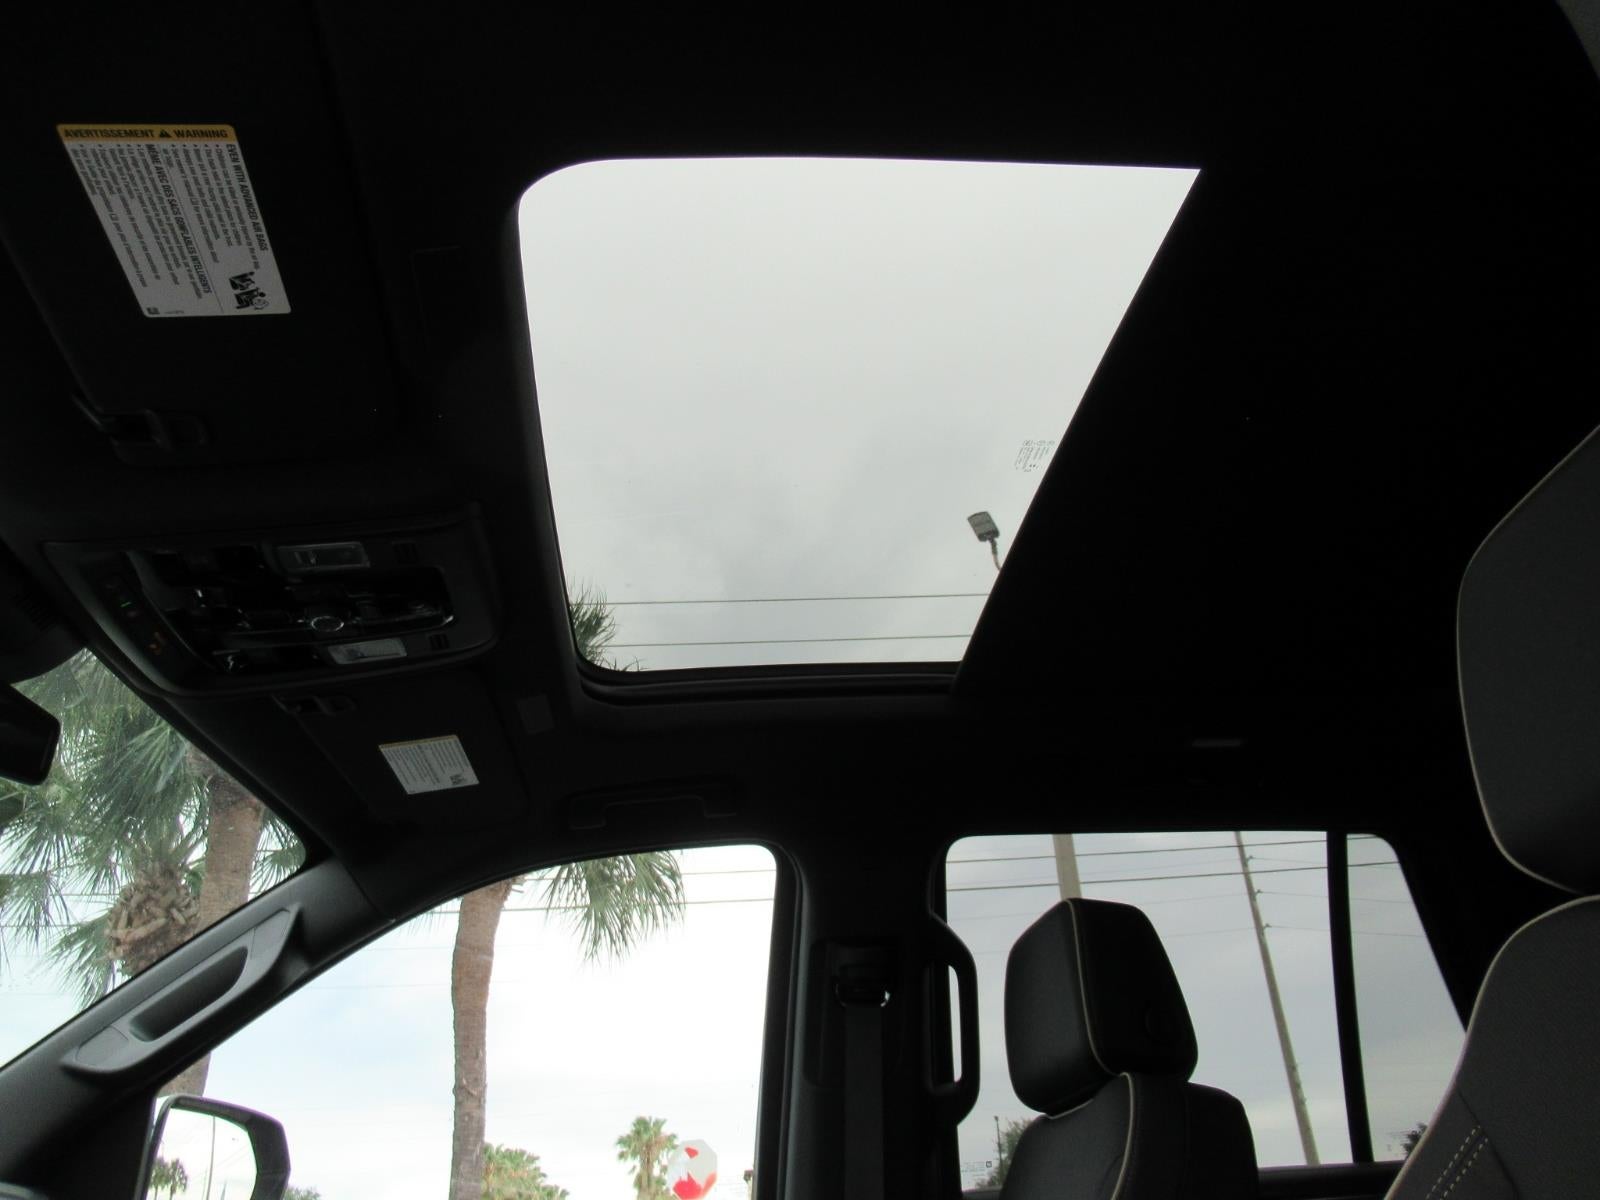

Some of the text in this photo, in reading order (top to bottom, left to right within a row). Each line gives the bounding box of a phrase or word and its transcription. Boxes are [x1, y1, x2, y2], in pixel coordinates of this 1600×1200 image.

[63, 129, 228, 138] AVERTISSEMENT WARNING
[154, 166, 168, 182] AVEC
[161, 185, 174, 197] DES
[226, 144, 268, 250] EVEN WITH ADVANCED AIR BAGS
[167, 198, 181, 214] SACS
